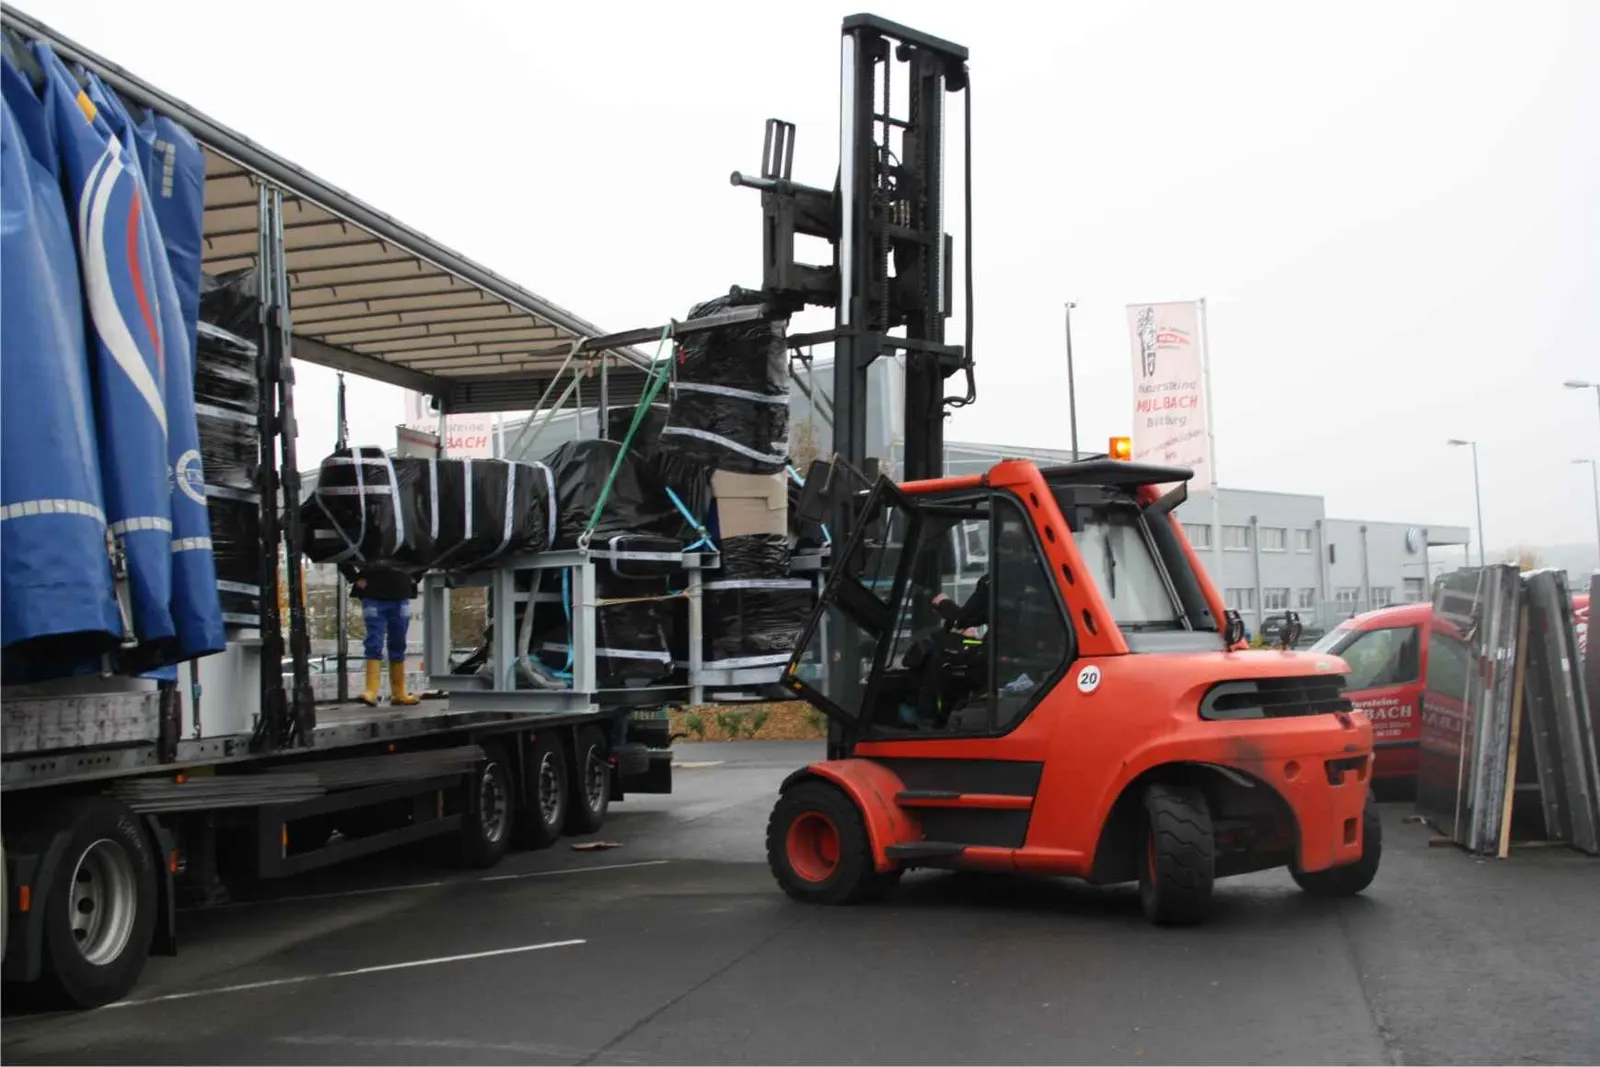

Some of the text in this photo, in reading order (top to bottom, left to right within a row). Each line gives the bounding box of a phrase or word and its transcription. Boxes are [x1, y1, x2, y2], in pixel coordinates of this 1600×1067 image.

[446, 436, 487, 449] BACH
[1080, 672, 1098, 685] 20
[1365, 705, 1413, 720] BACH
